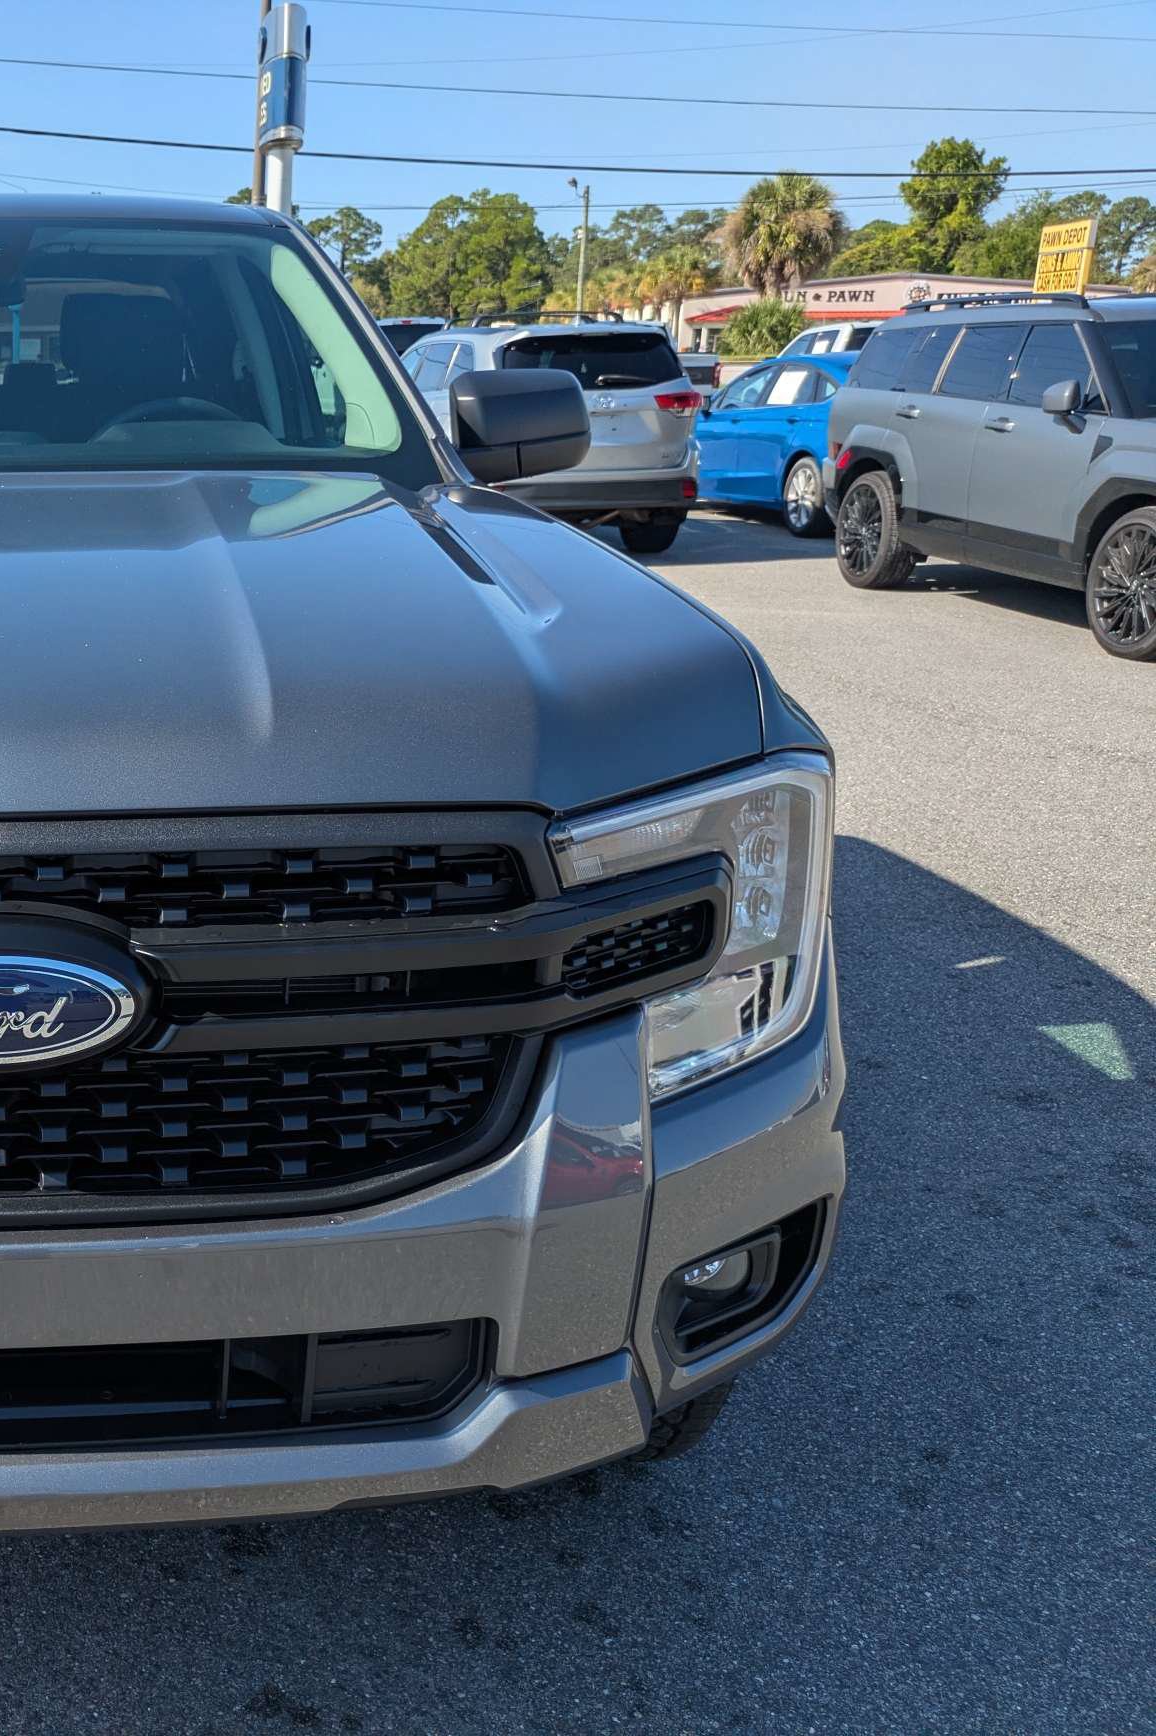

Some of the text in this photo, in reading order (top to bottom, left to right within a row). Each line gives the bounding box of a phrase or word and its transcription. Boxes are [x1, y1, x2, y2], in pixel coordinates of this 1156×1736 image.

[1042, 226, 1088, 249] PAWN DEPOT
[1037, 271, 1078, 291] CASH FOR GOLD
[783, 290, 807, 303] UN
[827, 290, 875, 303] PAWN
